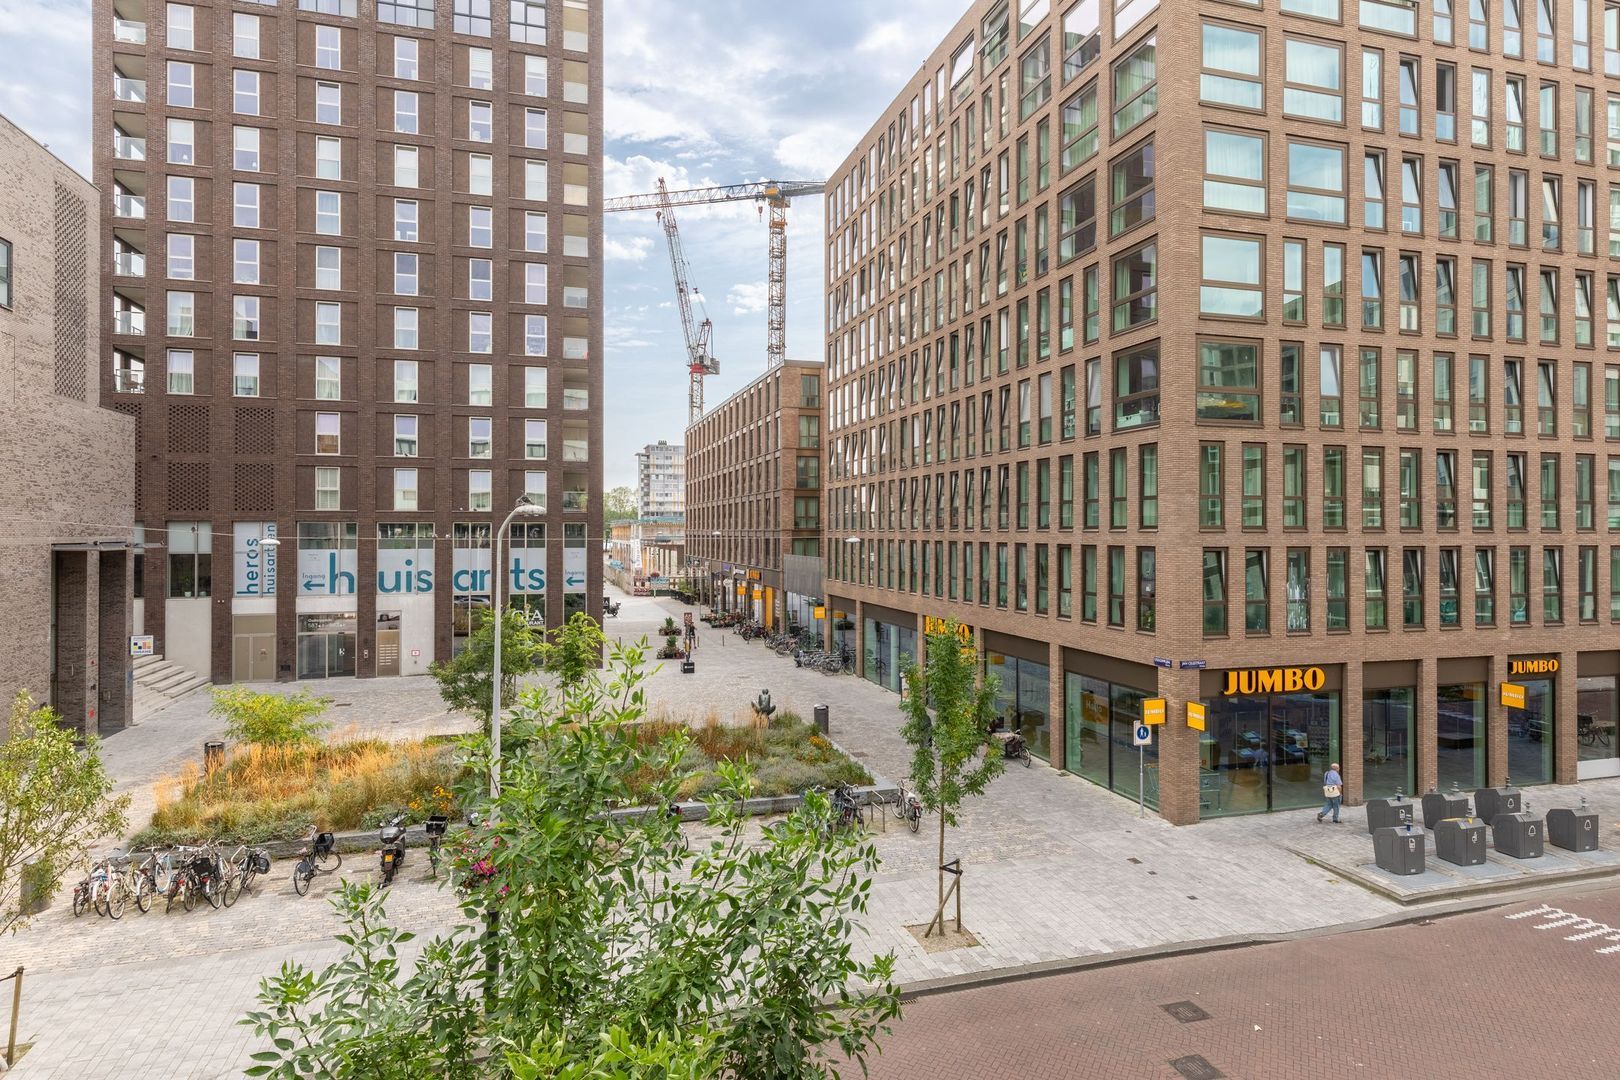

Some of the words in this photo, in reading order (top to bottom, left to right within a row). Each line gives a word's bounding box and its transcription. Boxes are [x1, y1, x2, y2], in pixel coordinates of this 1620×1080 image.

[236, 538, 259, 595] heros
[262, 525, 276, 594] huisarten
[302, 572, 326, 580] Ingang
[1510, 659, 1559, 674] JUMBO
[1223, 667, 1325, 695] JUMBO
